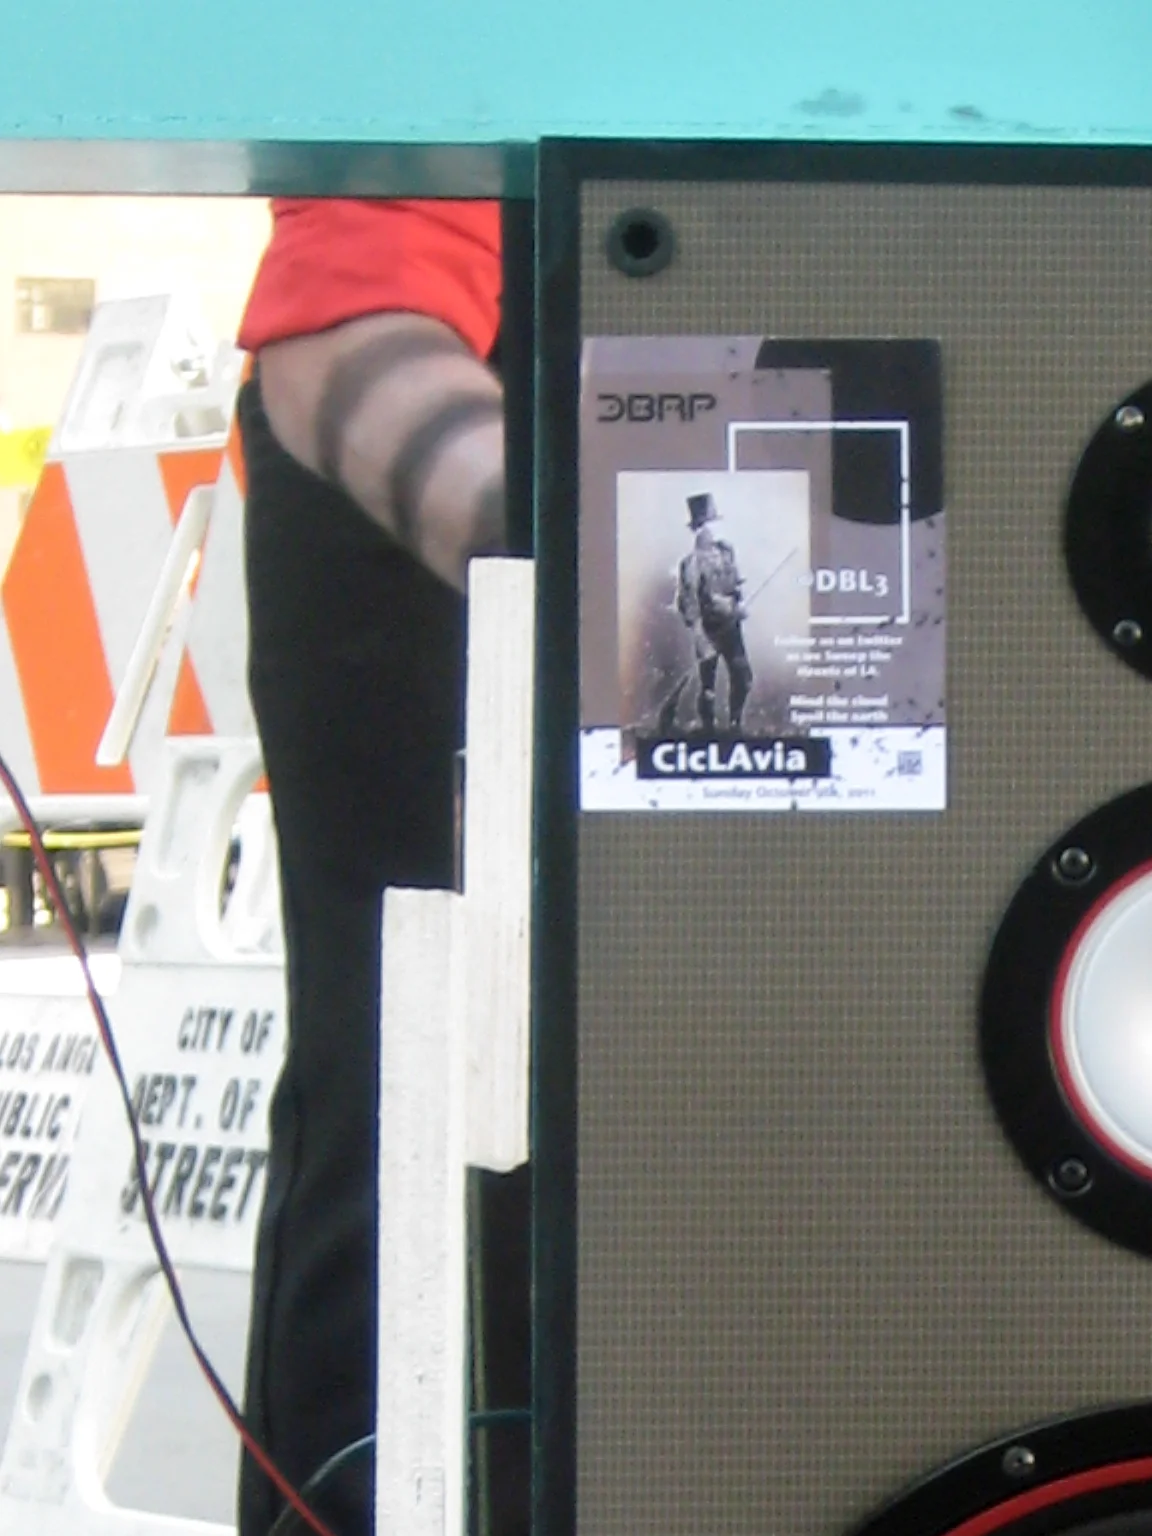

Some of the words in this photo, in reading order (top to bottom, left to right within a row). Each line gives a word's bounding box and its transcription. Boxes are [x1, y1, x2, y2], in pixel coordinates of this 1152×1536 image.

[651, 741, 807, 773] CicLAvia
[177, 1007, 238, 1051] CITY
[240, 1009, 276, 1054] OF
[219, 1078, 261, 1133] OF
